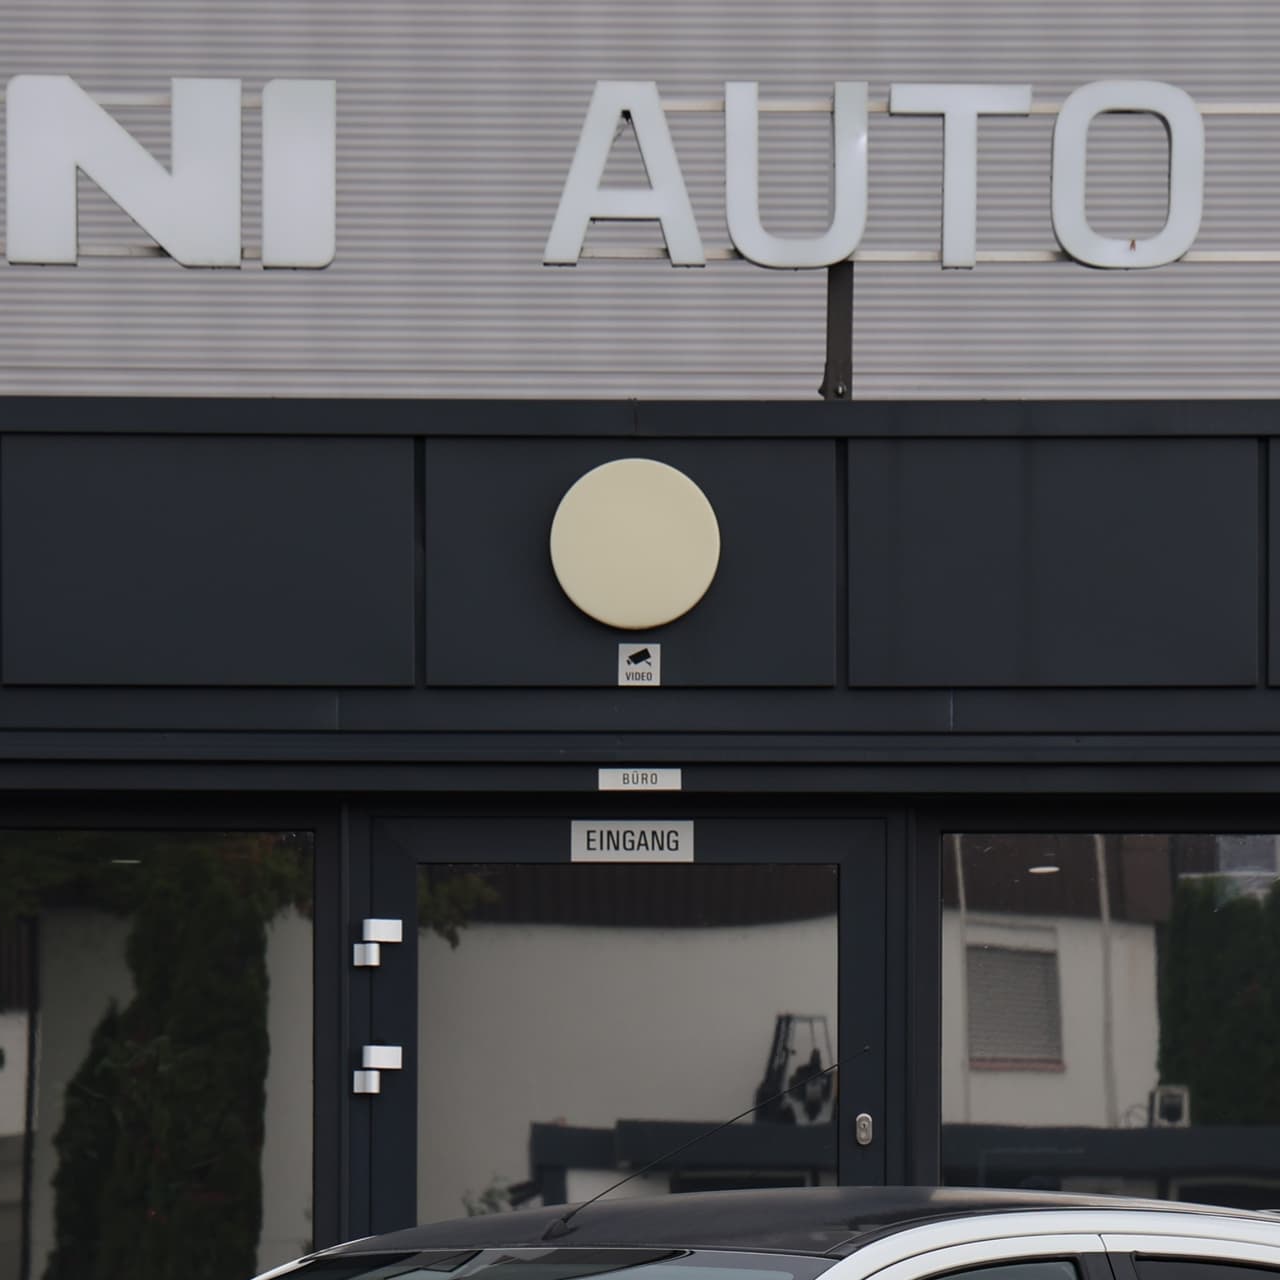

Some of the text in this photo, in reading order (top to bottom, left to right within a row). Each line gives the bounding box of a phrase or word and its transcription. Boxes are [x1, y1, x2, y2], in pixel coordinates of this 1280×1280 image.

[542, 78, 1205, 270] AUTO
[625, 671, 653, 682] VIDEO
[622, 770, 659, 785] BÜRO
[586, 829, 680, 852] EINGANG
